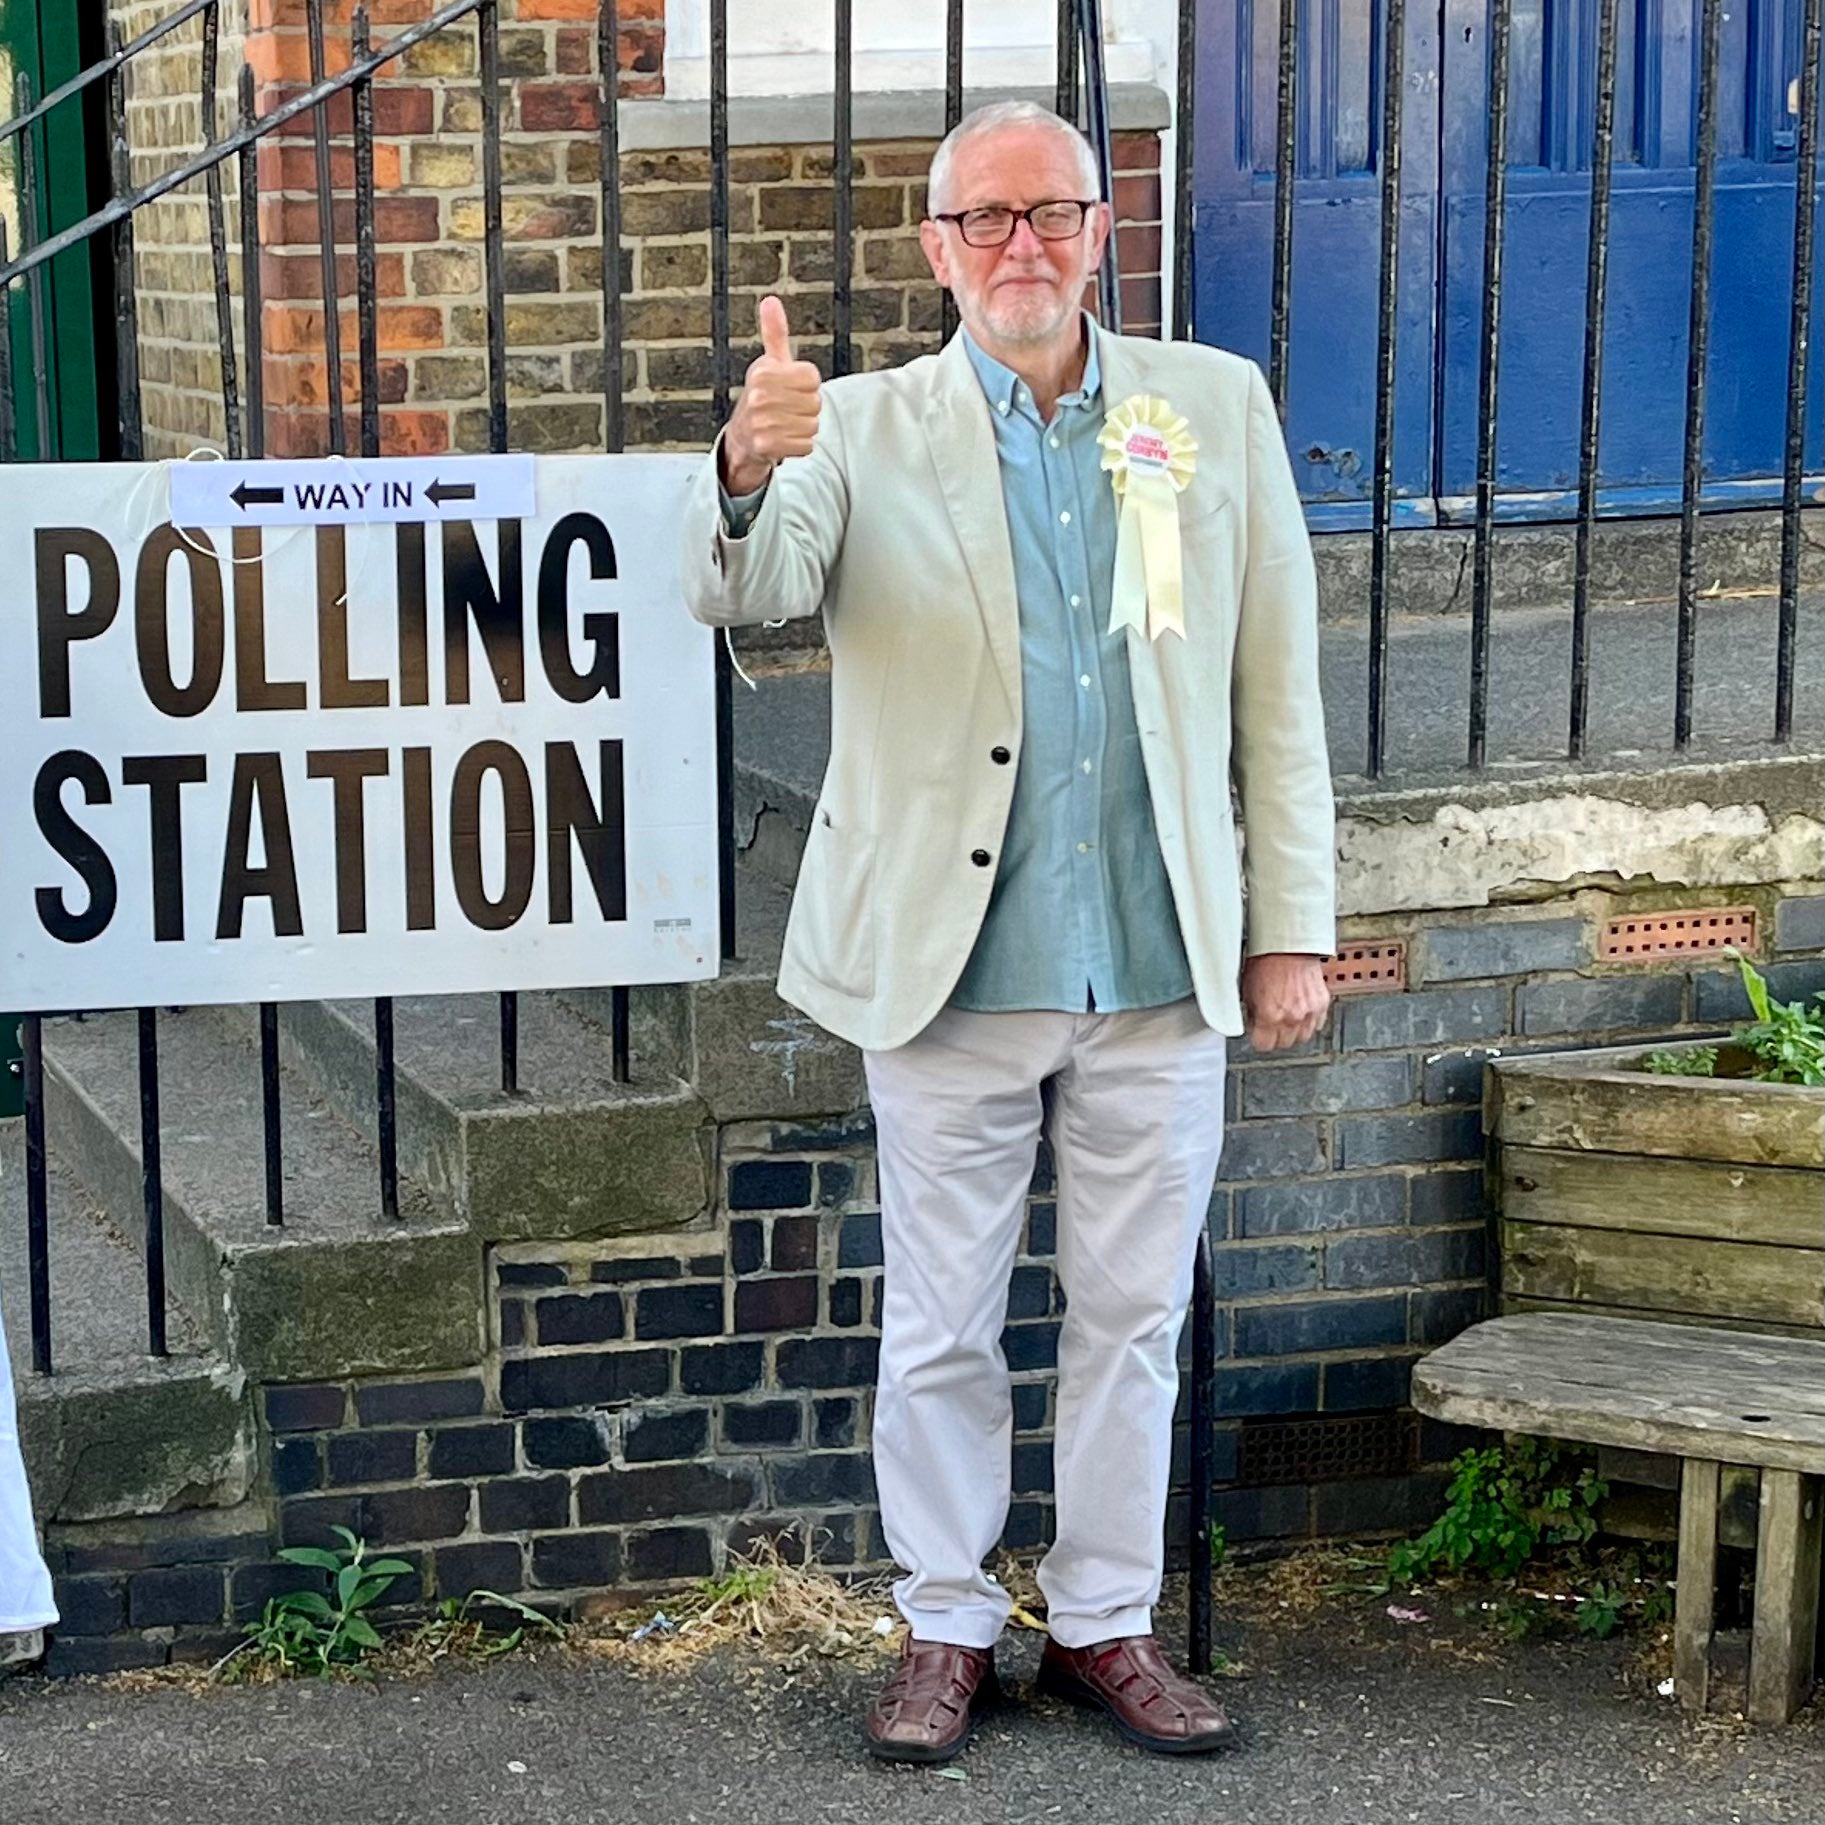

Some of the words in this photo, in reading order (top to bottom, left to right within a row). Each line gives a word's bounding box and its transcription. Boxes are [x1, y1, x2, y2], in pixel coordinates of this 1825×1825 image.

[295, 483, 372, 509] WAY
[383, 482, 412, 508] IN
[35, 511, 620, 718] POLLING
[34, 738, 627, 943] STATION
